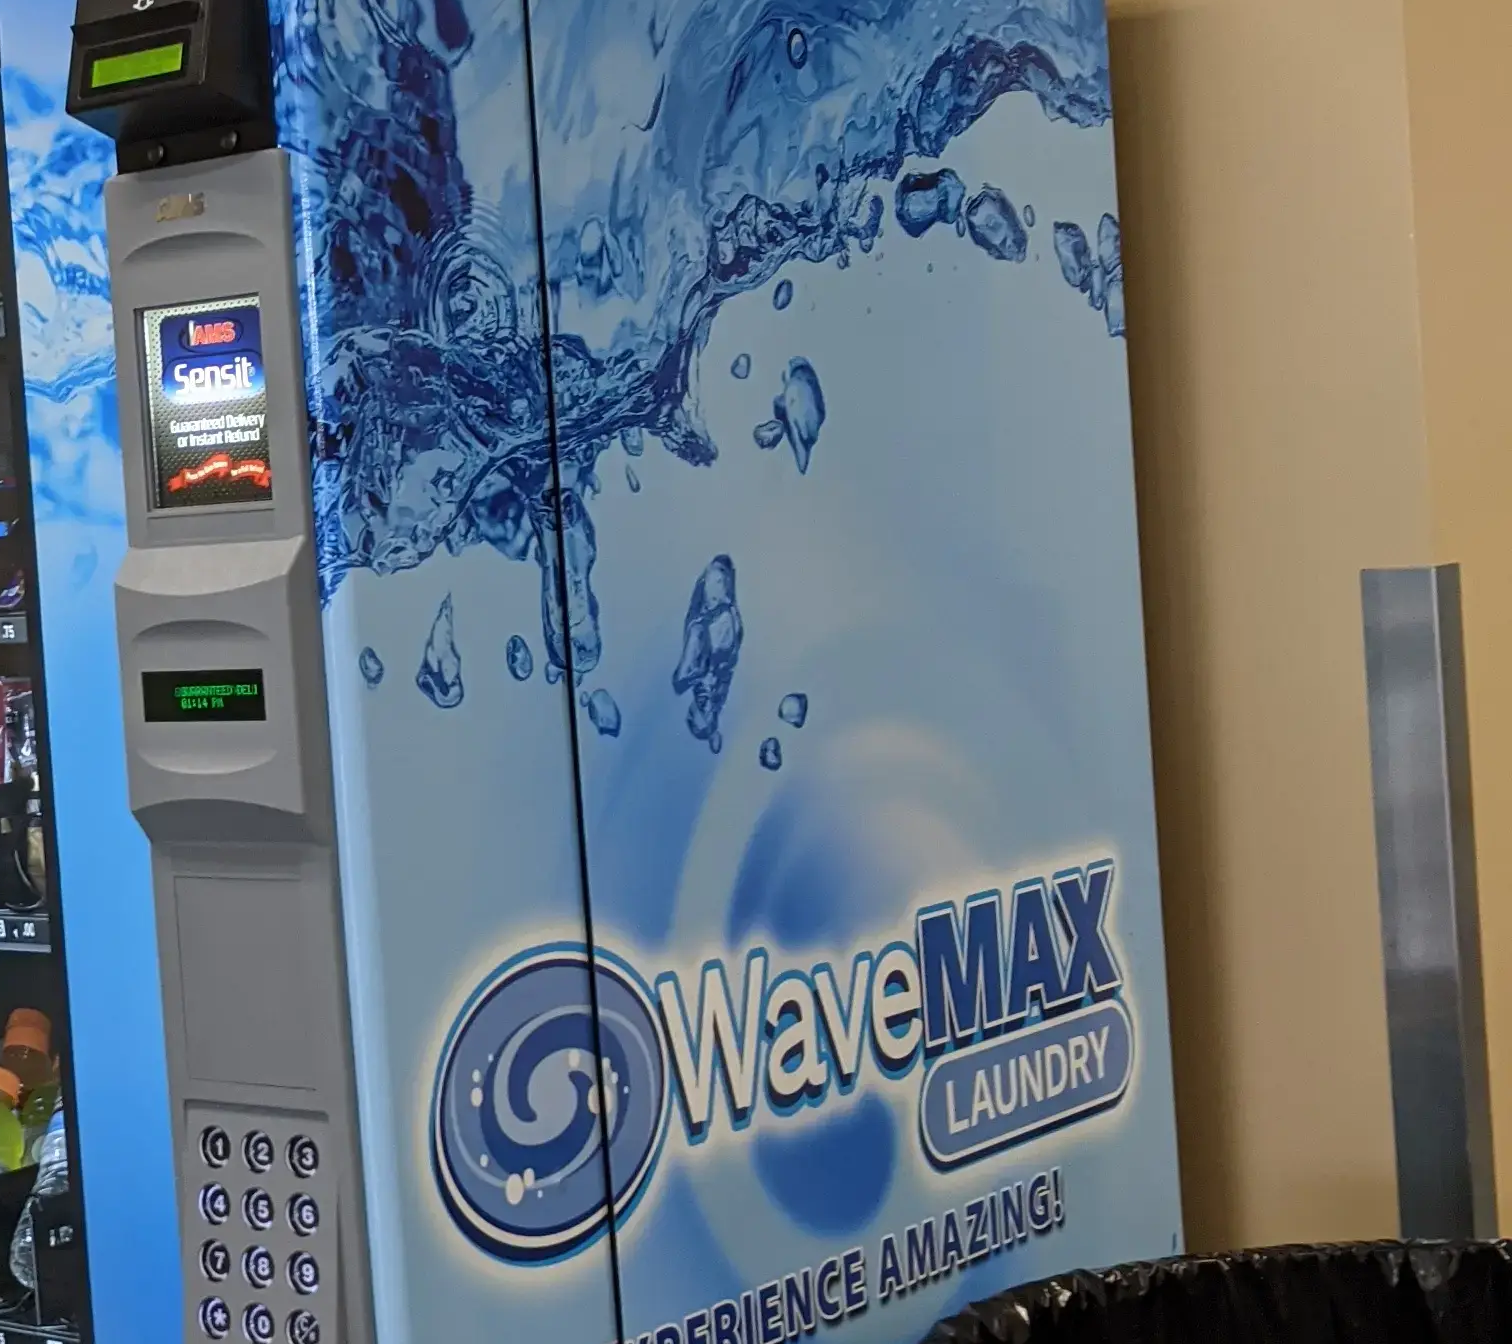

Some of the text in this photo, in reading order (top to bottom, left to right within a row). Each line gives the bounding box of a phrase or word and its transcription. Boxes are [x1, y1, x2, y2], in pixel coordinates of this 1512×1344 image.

[174, 356, 253, 398] Sensit
[170, 413, 265, 433] Guaranteed Delivery
[177, 428, 260, 448] or Instant Refund
[656, 861, 1123, 1144] WaveMAX
[945, 1026, 1112, 1135] LAUNDRY
[214, 1137, 314, 1166] 1 2 3
[212, 1193, 315, 1224] 4 5 6
[877, 1167, 1066, 1302] AMAZING!
[213, 1250, 314, 1283] 7 8 9
[258, 1315, 270, 1334] 0
